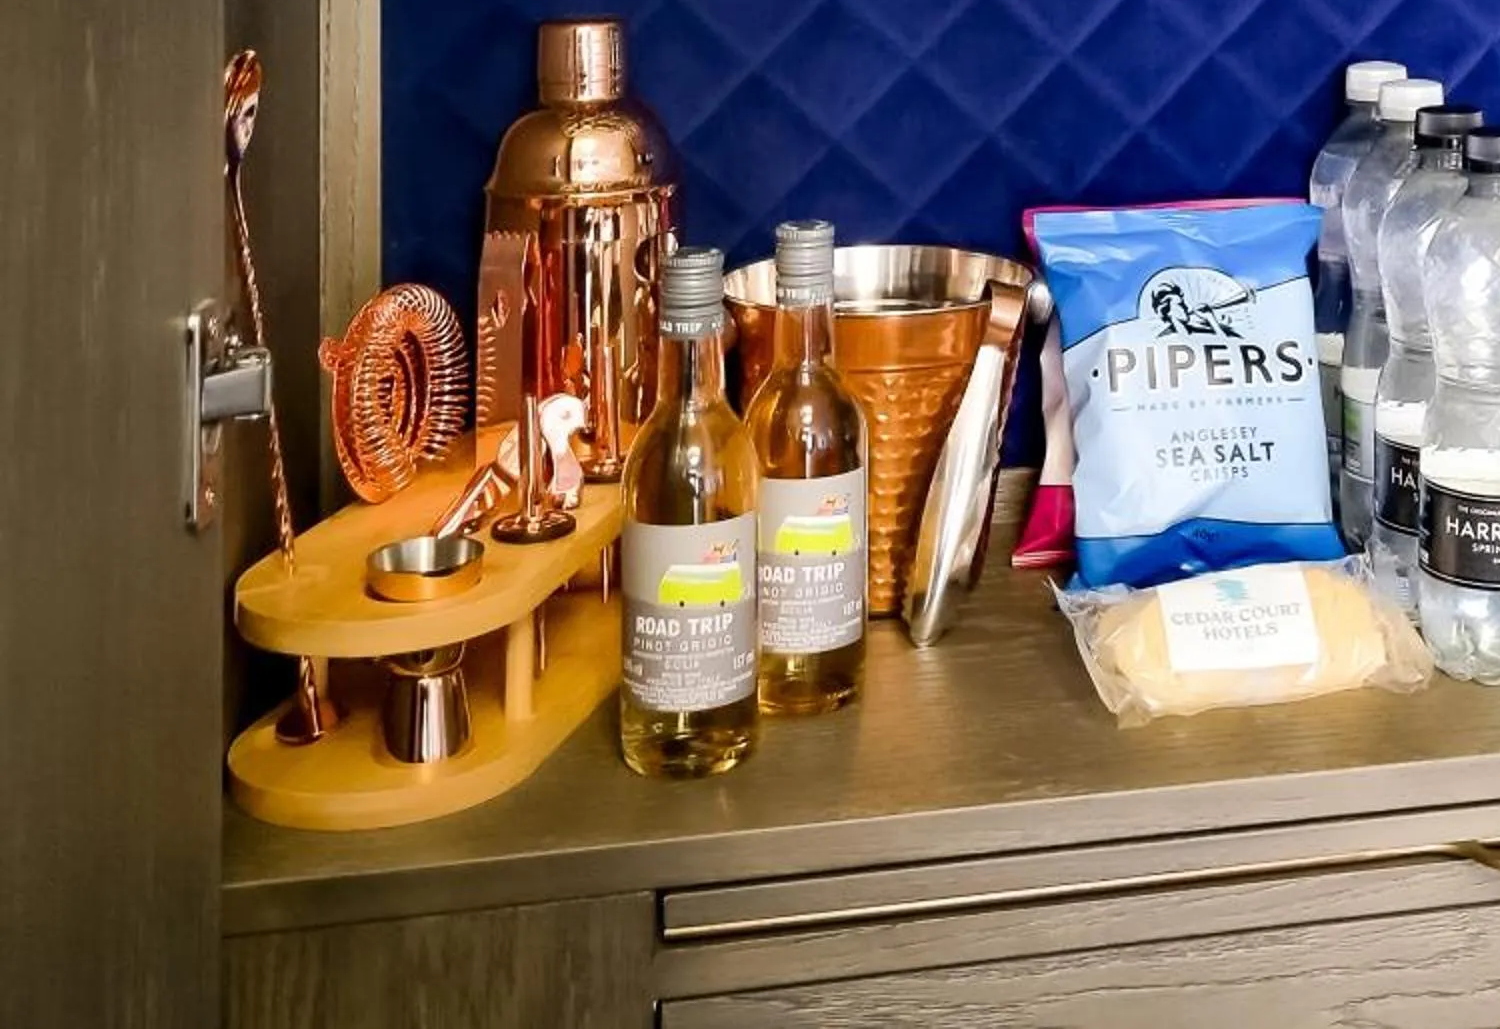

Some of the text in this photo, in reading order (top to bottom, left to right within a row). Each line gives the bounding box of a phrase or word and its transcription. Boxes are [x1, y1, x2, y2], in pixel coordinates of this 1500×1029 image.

[1107, 340, 1304, 394] PIPERS
[1170, 426, 1258, 444] ANGLESEY
[1155, 441, 1276, 469] SEA SALT
[1190, 465, 1250, 483] CRISPS
[801, 561, 845, 583] TRIP
[635, 612, 733, 637] ROAD TRIP
[1170, 602, 1303, 627] CEDAR COURT
[1204, 621, 1279, 642] HOTELS
[632, 634, 733, 652] PINOT GRIGIO
